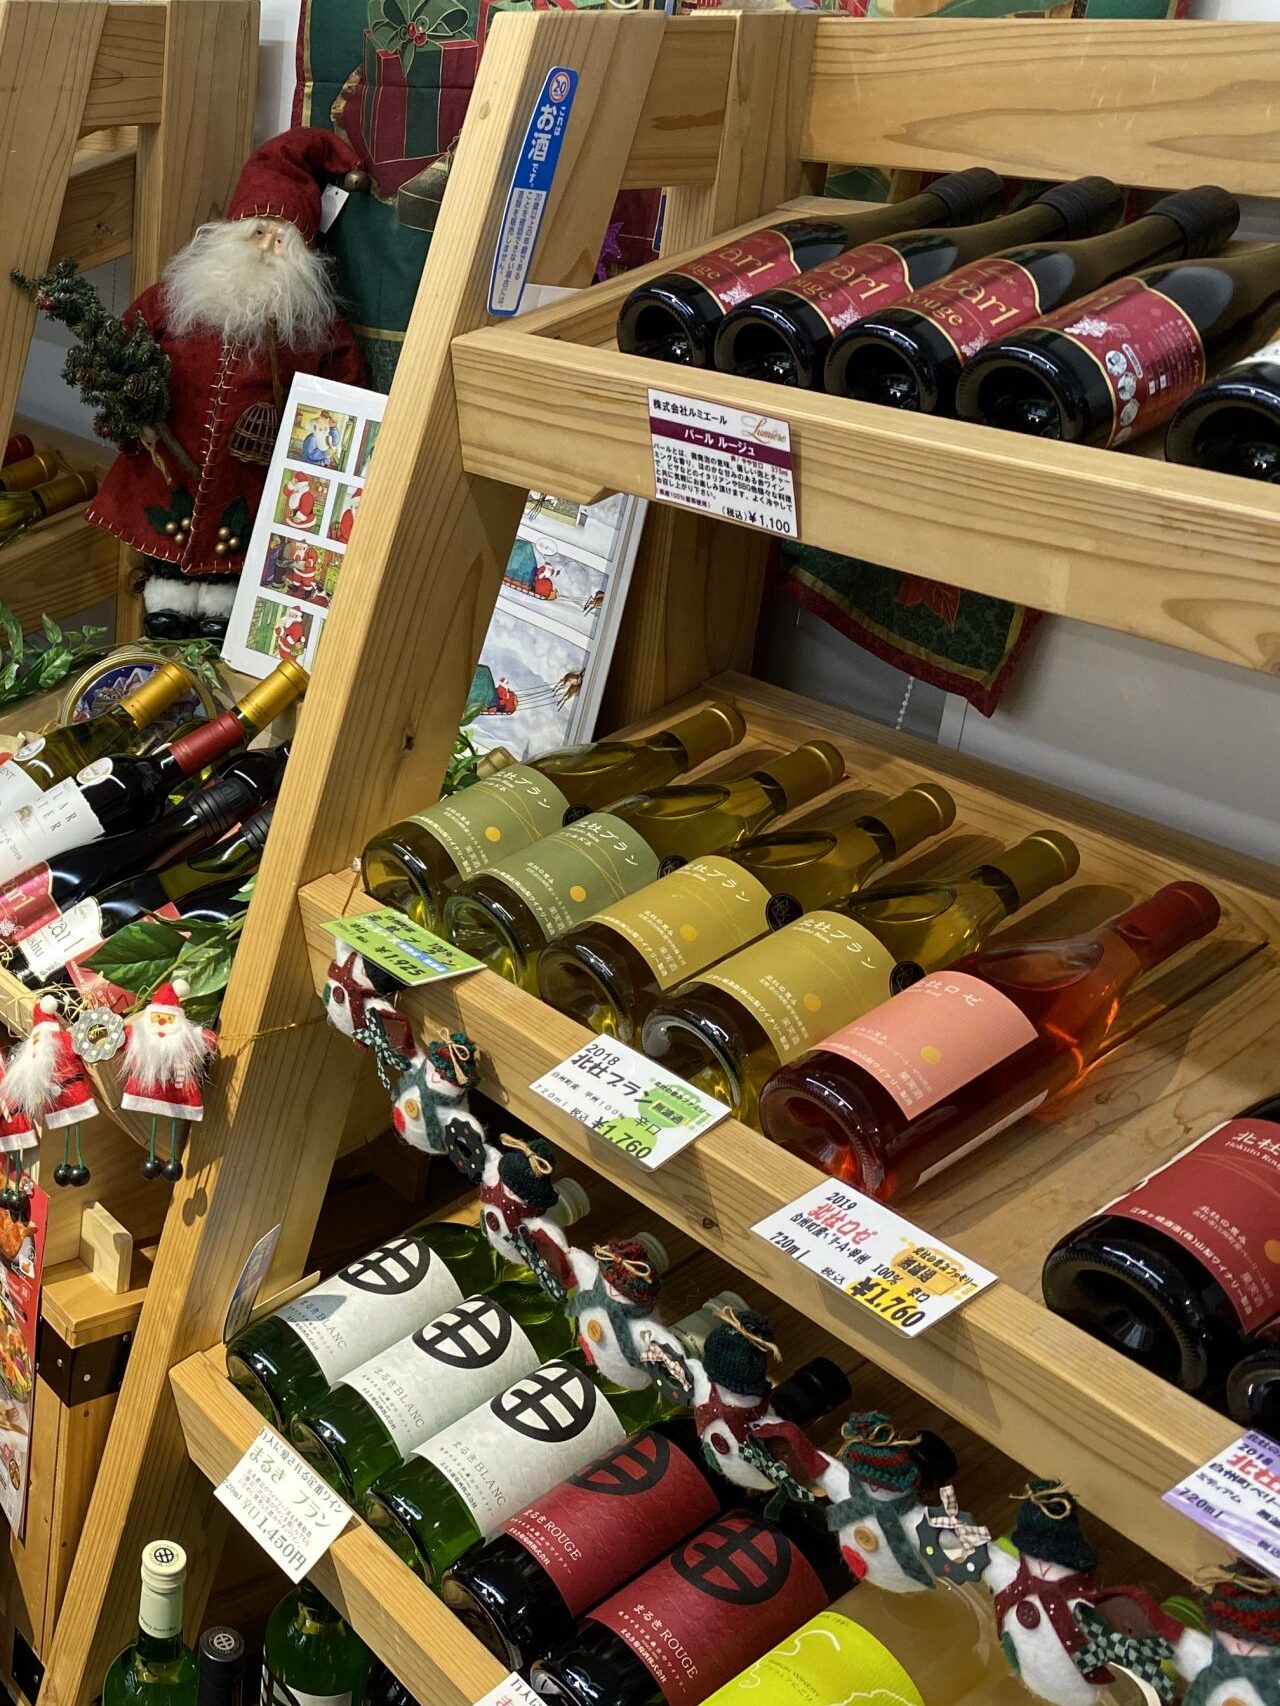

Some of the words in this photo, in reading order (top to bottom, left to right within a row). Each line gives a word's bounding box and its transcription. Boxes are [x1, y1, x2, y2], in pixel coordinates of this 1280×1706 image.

[552, 105, 567, 136] これは
[528, 104, 558, 188] お酒です。
[653, 398, 728, 426] 株式会社ルミエール
[684, 428, 714, 446] パール
[718, 435, 756, 457] ルージュ
[374, 945, 426, 976] ¥1,925
[585, 1043, 621, 1067] 2018
[571, 1053, 653, 1104] 北杜ブラン
[550, 1070, 582, 1091] 白州町産
[584, 1089, 626, 1121] 甲州100%
[570, 1106, 590, 1122] 税込
[633, 1116, 662, 1137] 辛口
[591, 1116, 653, 1160] ¥1,760
[825, 1191, 858, 1211] 2019
[807, 1202, 879, 1246] 北杜ロゼ
[769, 1231, 811, 1262] 720ml
[820, 1266, 847, 1286] 税込
[906, 1287, 931, 1304] 辛口
[871, 1262, 904, 1286] 100%
[849, 1276, 928, 1328] ¥1,760
[1237, 1442, 1274, 1466] 2018
[249, 1445, 287, 1485] まるき
[293, 1488, 332, 1528] ブラン
[1178, 1487, 1224, 1519] 720ml
[257, 1515, 308, 1573] 1,450円
